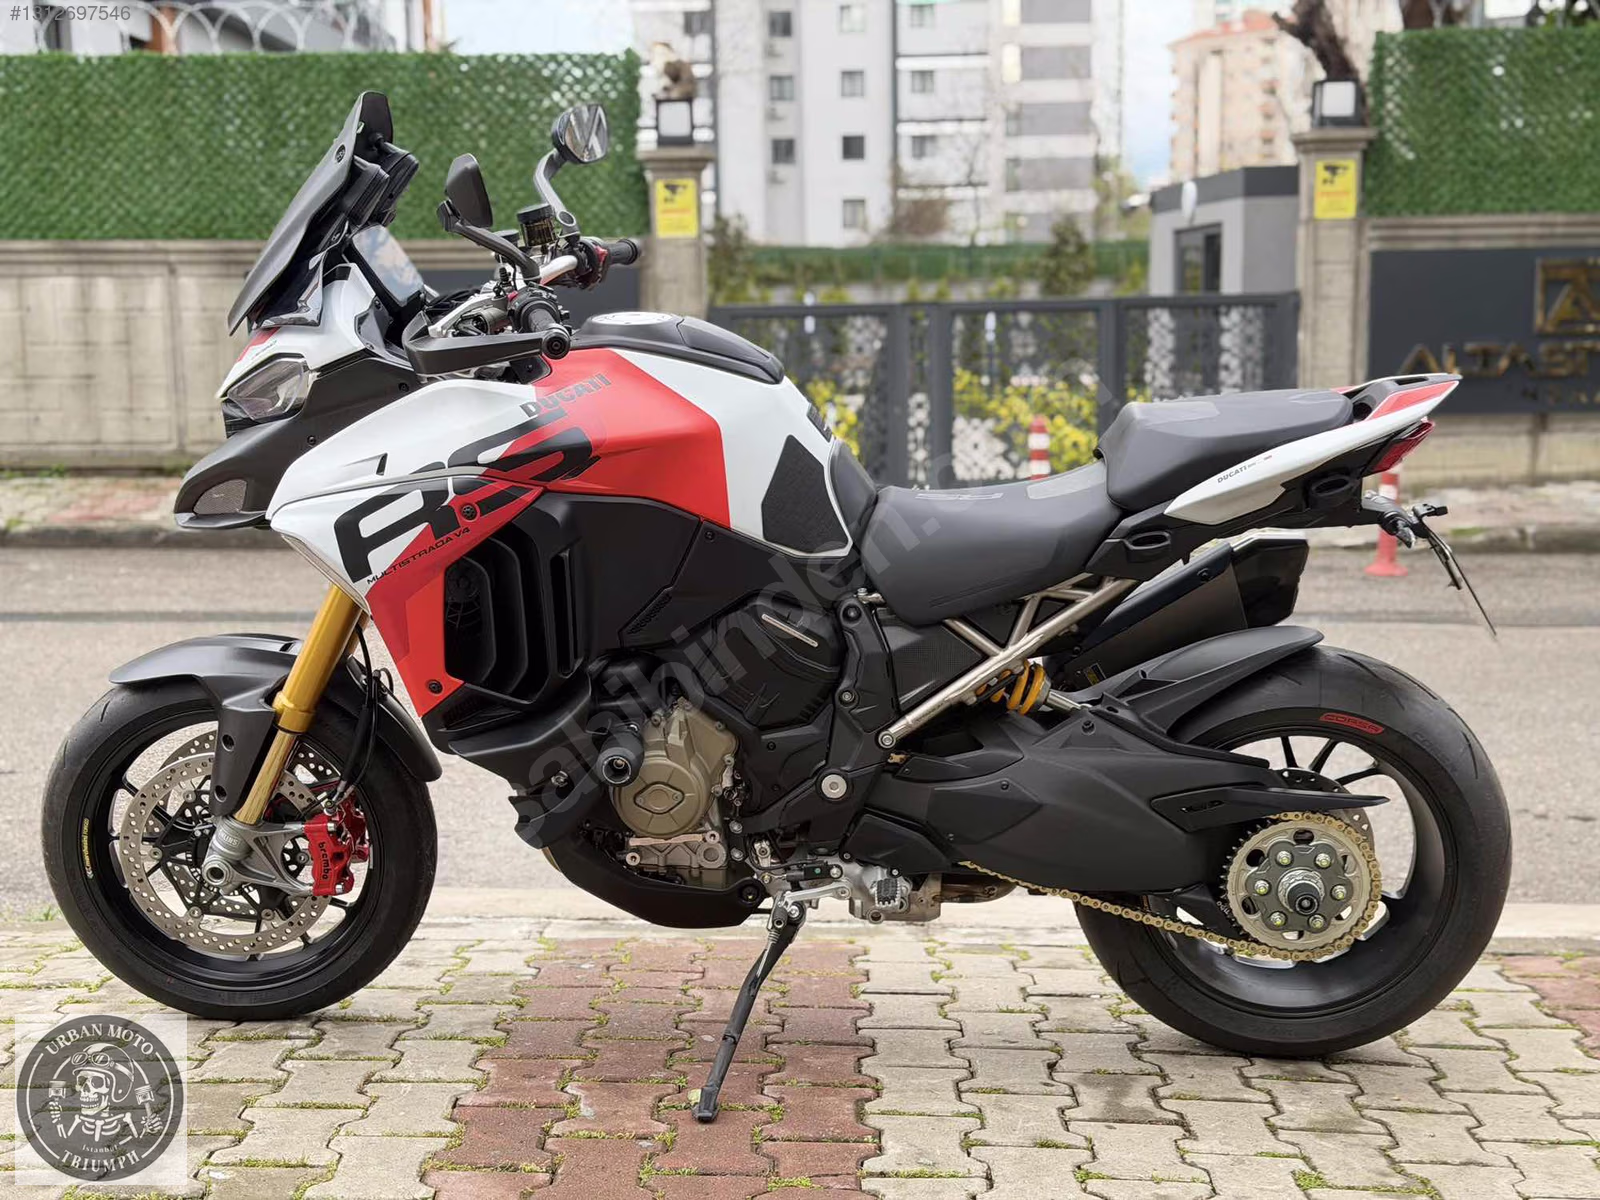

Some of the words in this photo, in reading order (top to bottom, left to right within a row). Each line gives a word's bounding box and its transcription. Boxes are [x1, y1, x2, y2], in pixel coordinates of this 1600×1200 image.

[519, 373, 613, 418] DUCATI
[1217, 465, 1248, 483] DUCATI
[366, 536, 454, 585] MULTISTRADA
[454, 526, 471, 538] V4
[318, 841, 330, 880] brembo
